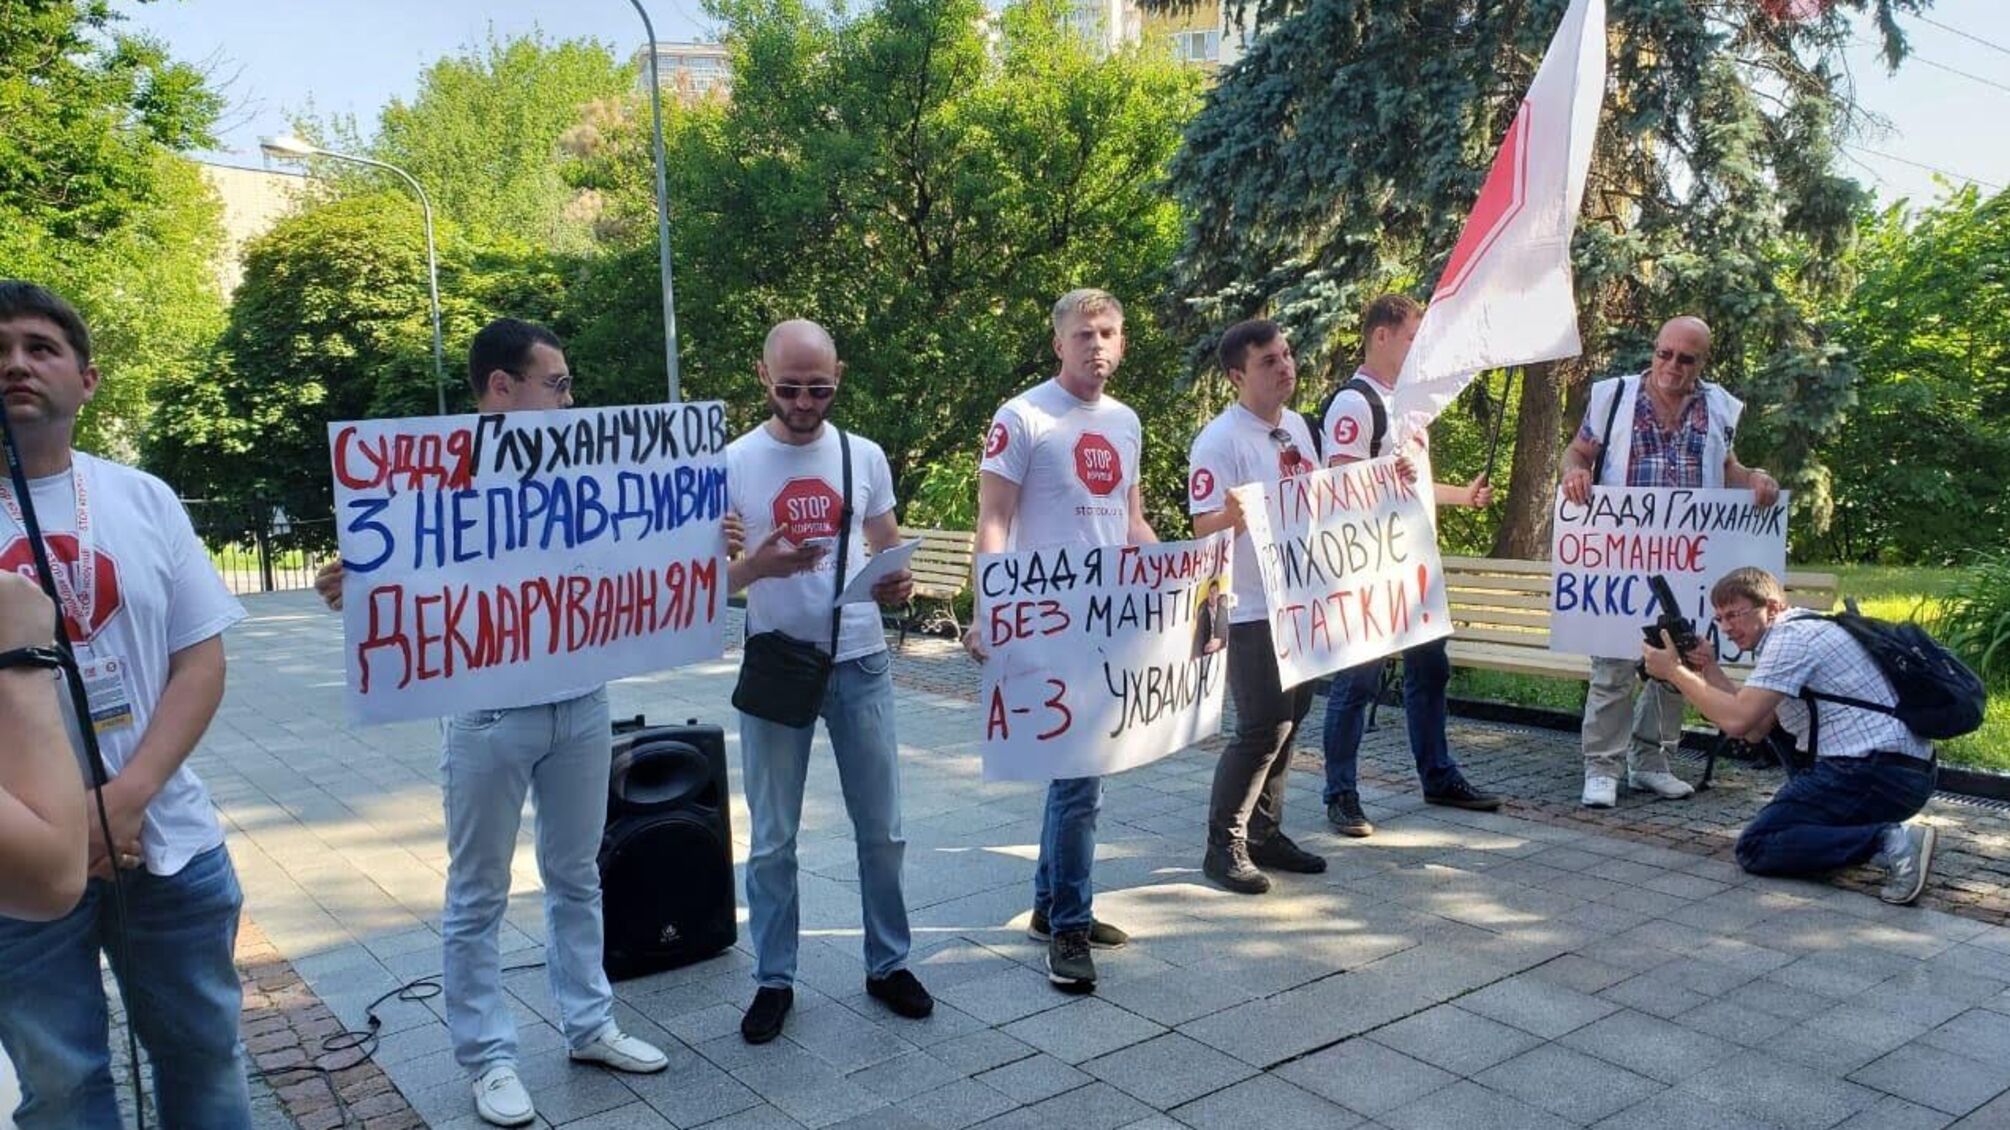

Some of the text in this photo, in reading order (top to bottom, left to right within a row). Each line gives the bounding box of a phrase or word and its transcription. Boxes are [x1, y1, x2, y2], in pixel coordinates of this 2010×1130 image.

[1084, 448, 1112, 469] STOP
[787, 495, 830, 520] STOP
[342, 497, 394, 572] З
[1559, 532, 1709, 573] ОБМАНЮЄ
[982, 547, 1102, 597] СУДДЯ
[358, 557, 718, 694] ДЕКЛАРУВАННЯМ
[991, 600, 1071, 647] БЕЗ
[1276, 564, 1430, 659] СТАТКИ!
[1104, 655, 1220, 738] УХВАЛОЮ
